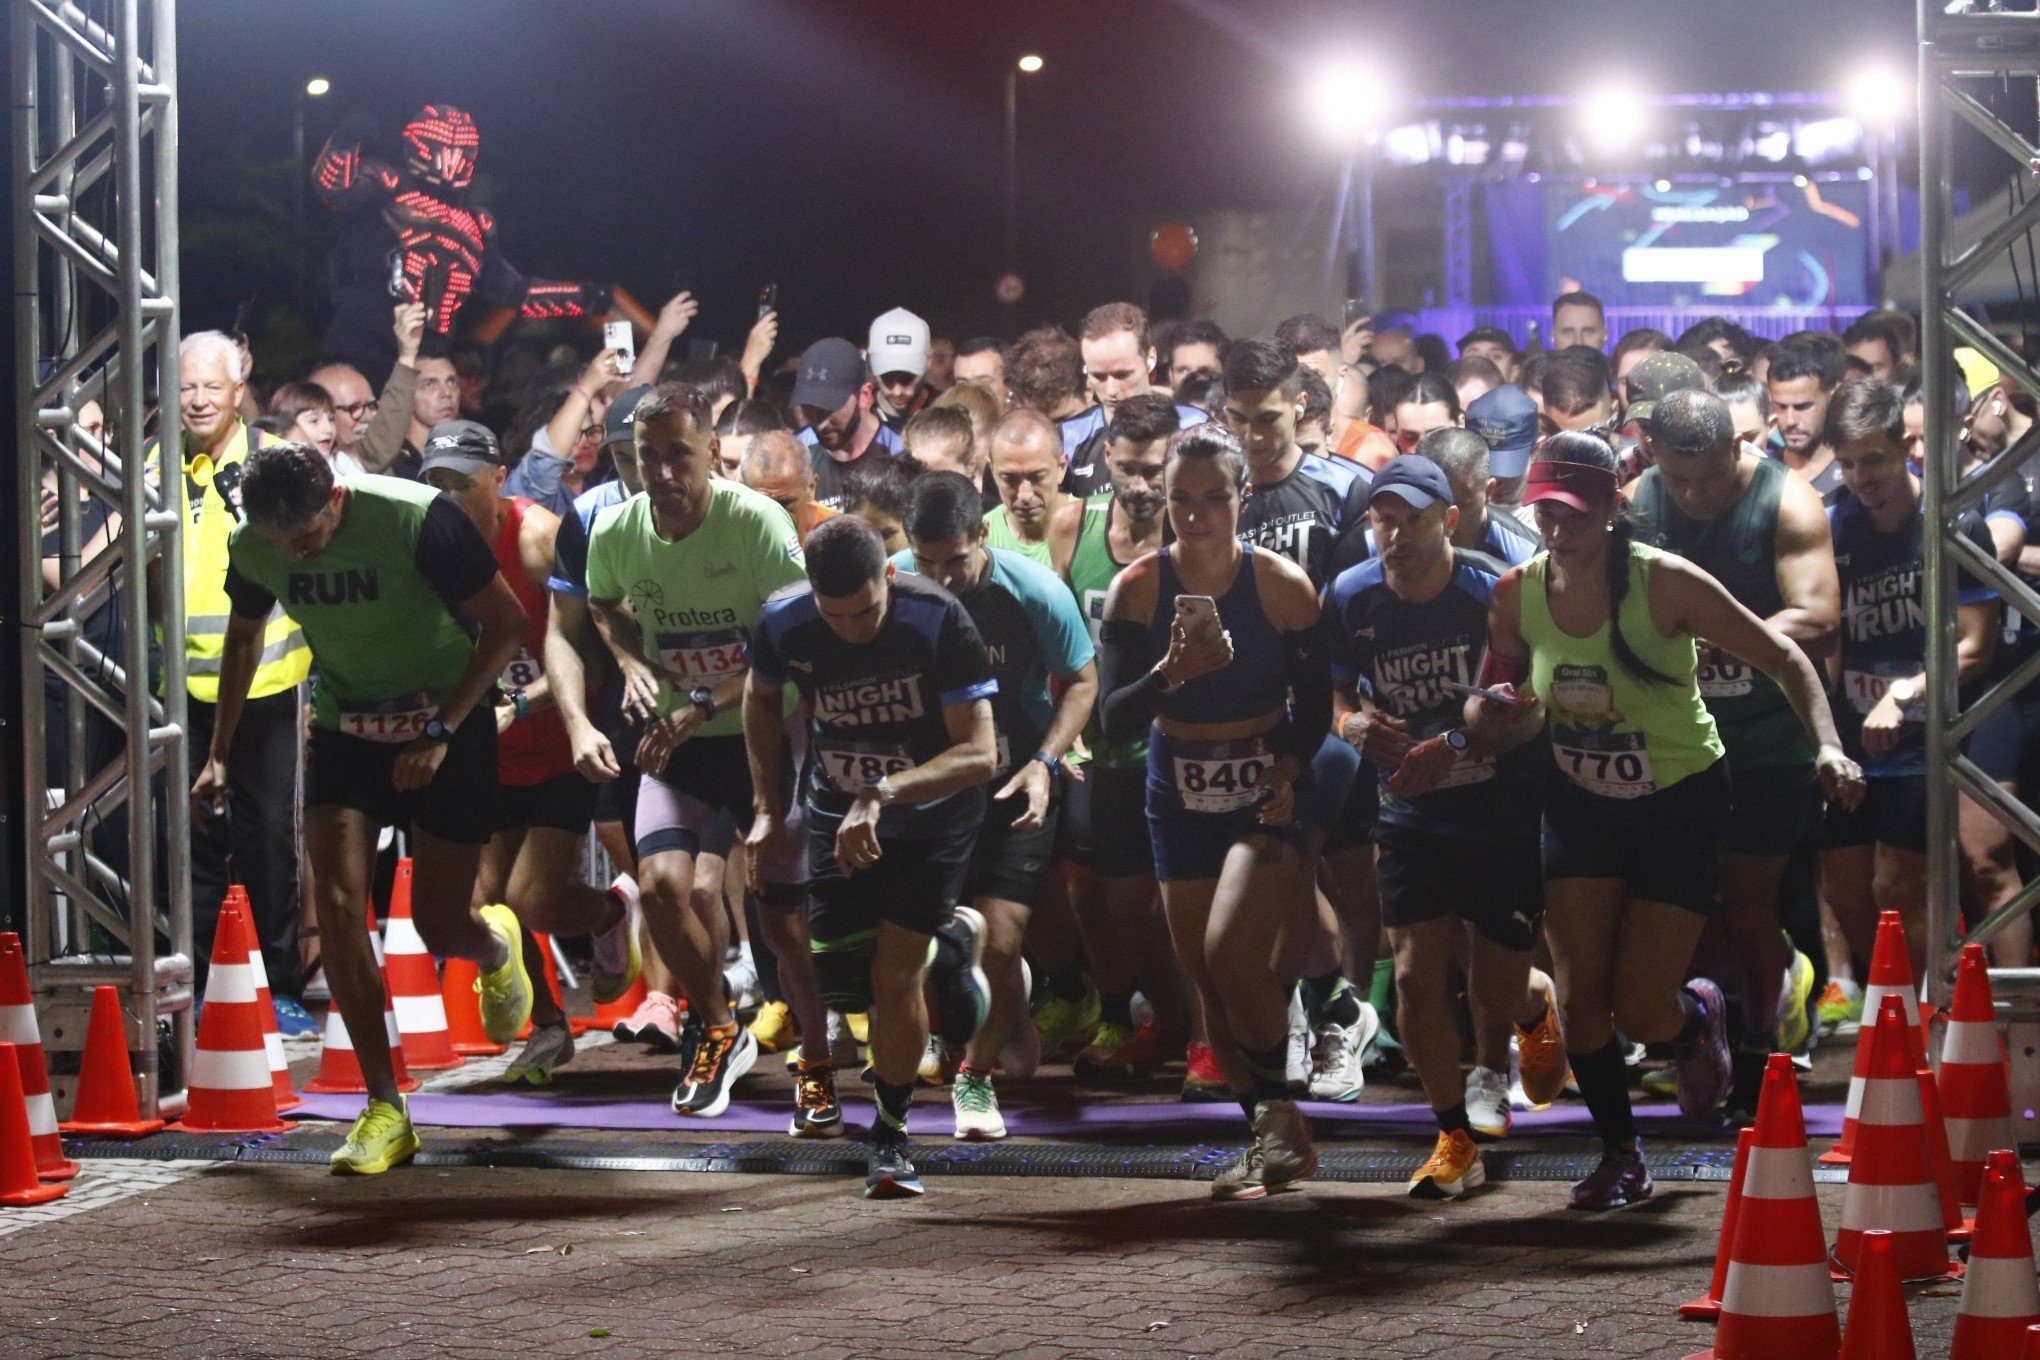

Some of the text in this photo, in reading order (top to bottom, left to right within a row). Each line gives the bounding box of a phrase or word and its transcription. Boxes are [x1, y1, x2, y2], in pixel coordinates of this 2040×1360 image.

[1237, 510, 1317, 540] FASO OUTLET
[288, 568, 379, 605] RUN
[1856, 570, 1928, 606] NIGHT
[653, 607, 737, 627] Protera
[671, 644, 749, 676] 1134
[1383, 644, 1471, 686] NIGHT
[1561, 667, 1597, 678] Oral Sin
[824, 673, 923, 716] NIGHT
[1854, 672, 1886, 700] 10
[1183, 760, 1265, 793] 840
[1561, 748, 1643, 782] 770
